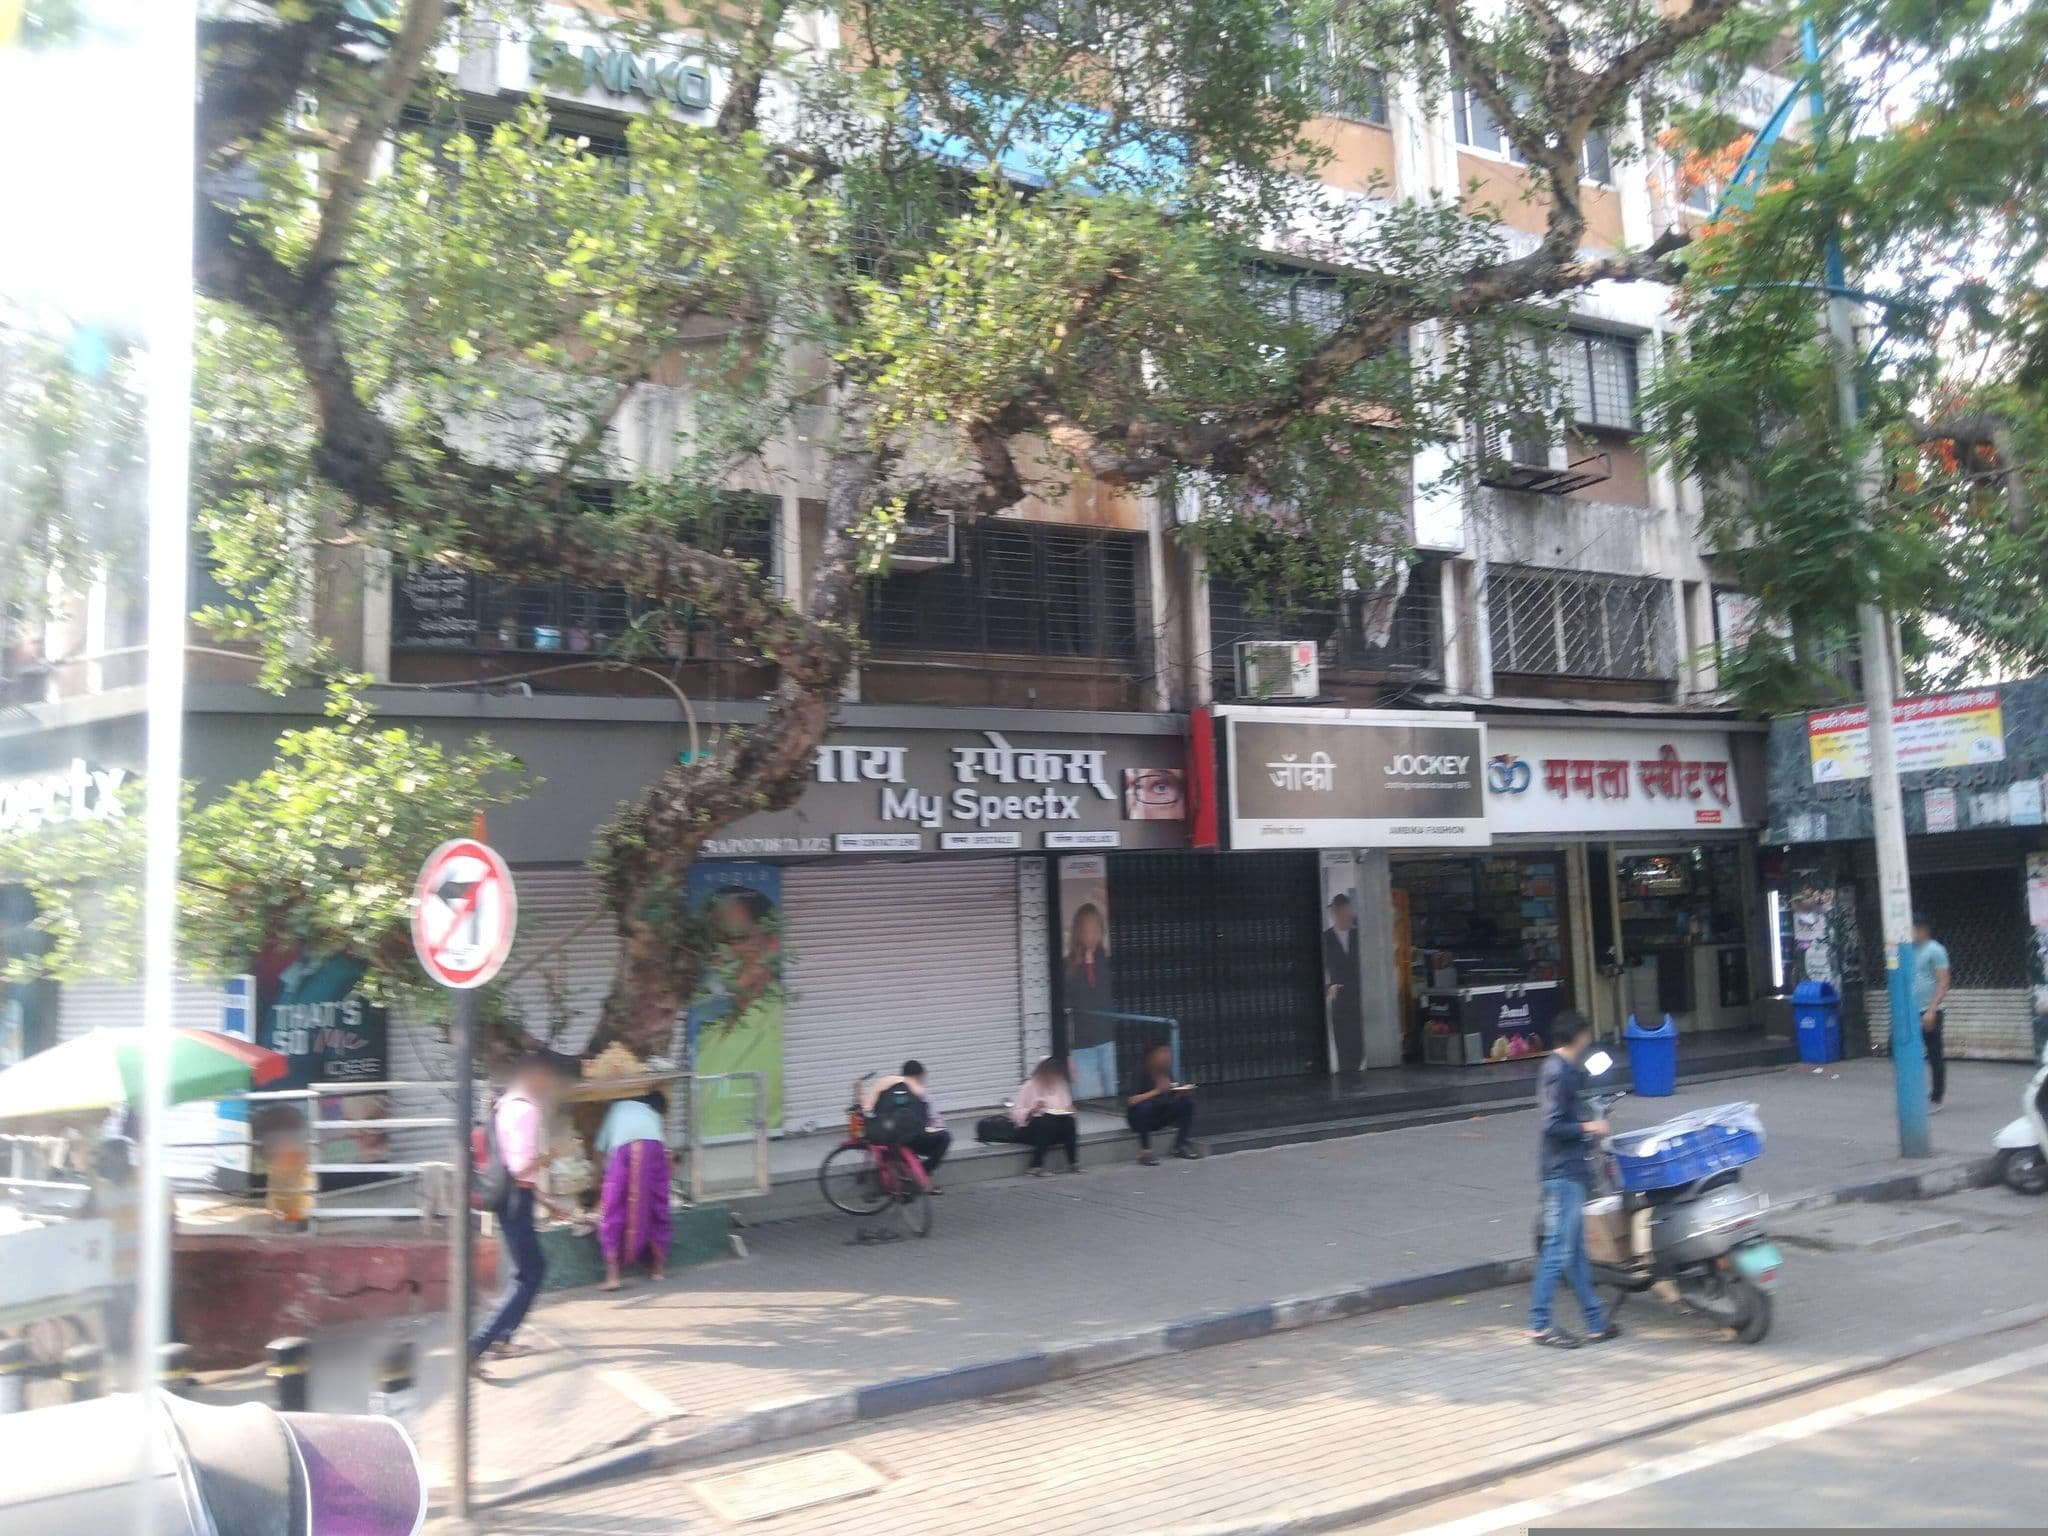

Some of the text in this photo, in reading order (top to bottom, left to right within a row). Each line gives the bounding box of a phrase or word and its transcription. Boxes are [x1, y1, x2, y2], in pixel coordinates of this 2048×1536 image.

[1264, 751, 1338, 792] जॉकी
[1383, 754, 1471, 776] JOCKEY
[1539, 759, 1629, 799] ममता
[881, 786, 1081, 828] My Spectx
[271, 1000, 363, 1030] THAT'S
[1499, 1003, 1529, 1018] Amul
